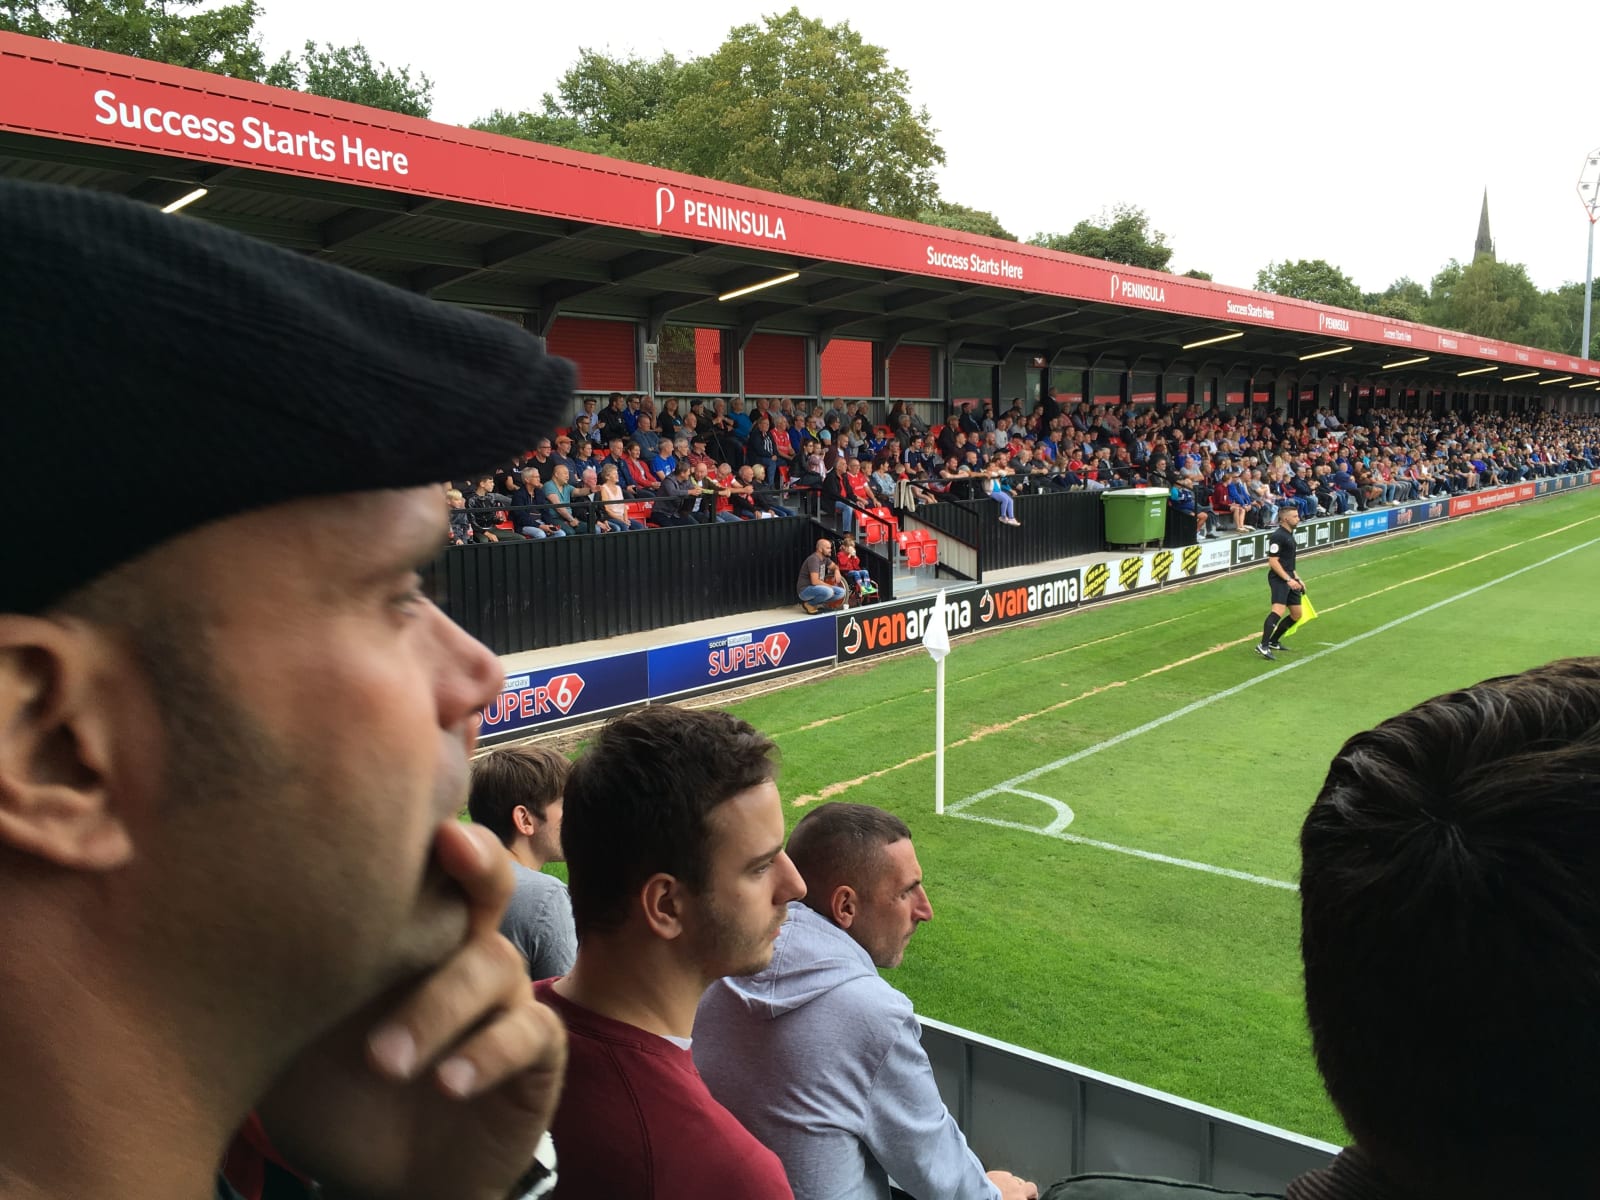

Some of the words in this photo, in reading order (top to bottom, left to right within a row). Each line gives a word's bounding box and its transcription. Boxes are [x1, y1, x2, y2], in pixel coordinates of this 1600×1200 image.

[93, 89, 236, 145] Success
[242, 116, 336, 163] Starts
[342, 135, 409, 175] Here
[684, 201, 787, 241] PENINSULA
[926, 246, 969, 271] Success
[970, 253, 1001, 277] Starts
[1001, 259, 1024, 280] Here
[1122, 281, 1165, 303] PENINSULA
[994, 577, 1078, 619] vanarama
[708, 641, 767, 677] SUPER
[770, 635, 781, 661] 6
[477, 685, 551, 728] UPER
[557, 677, 573, 708] 6
